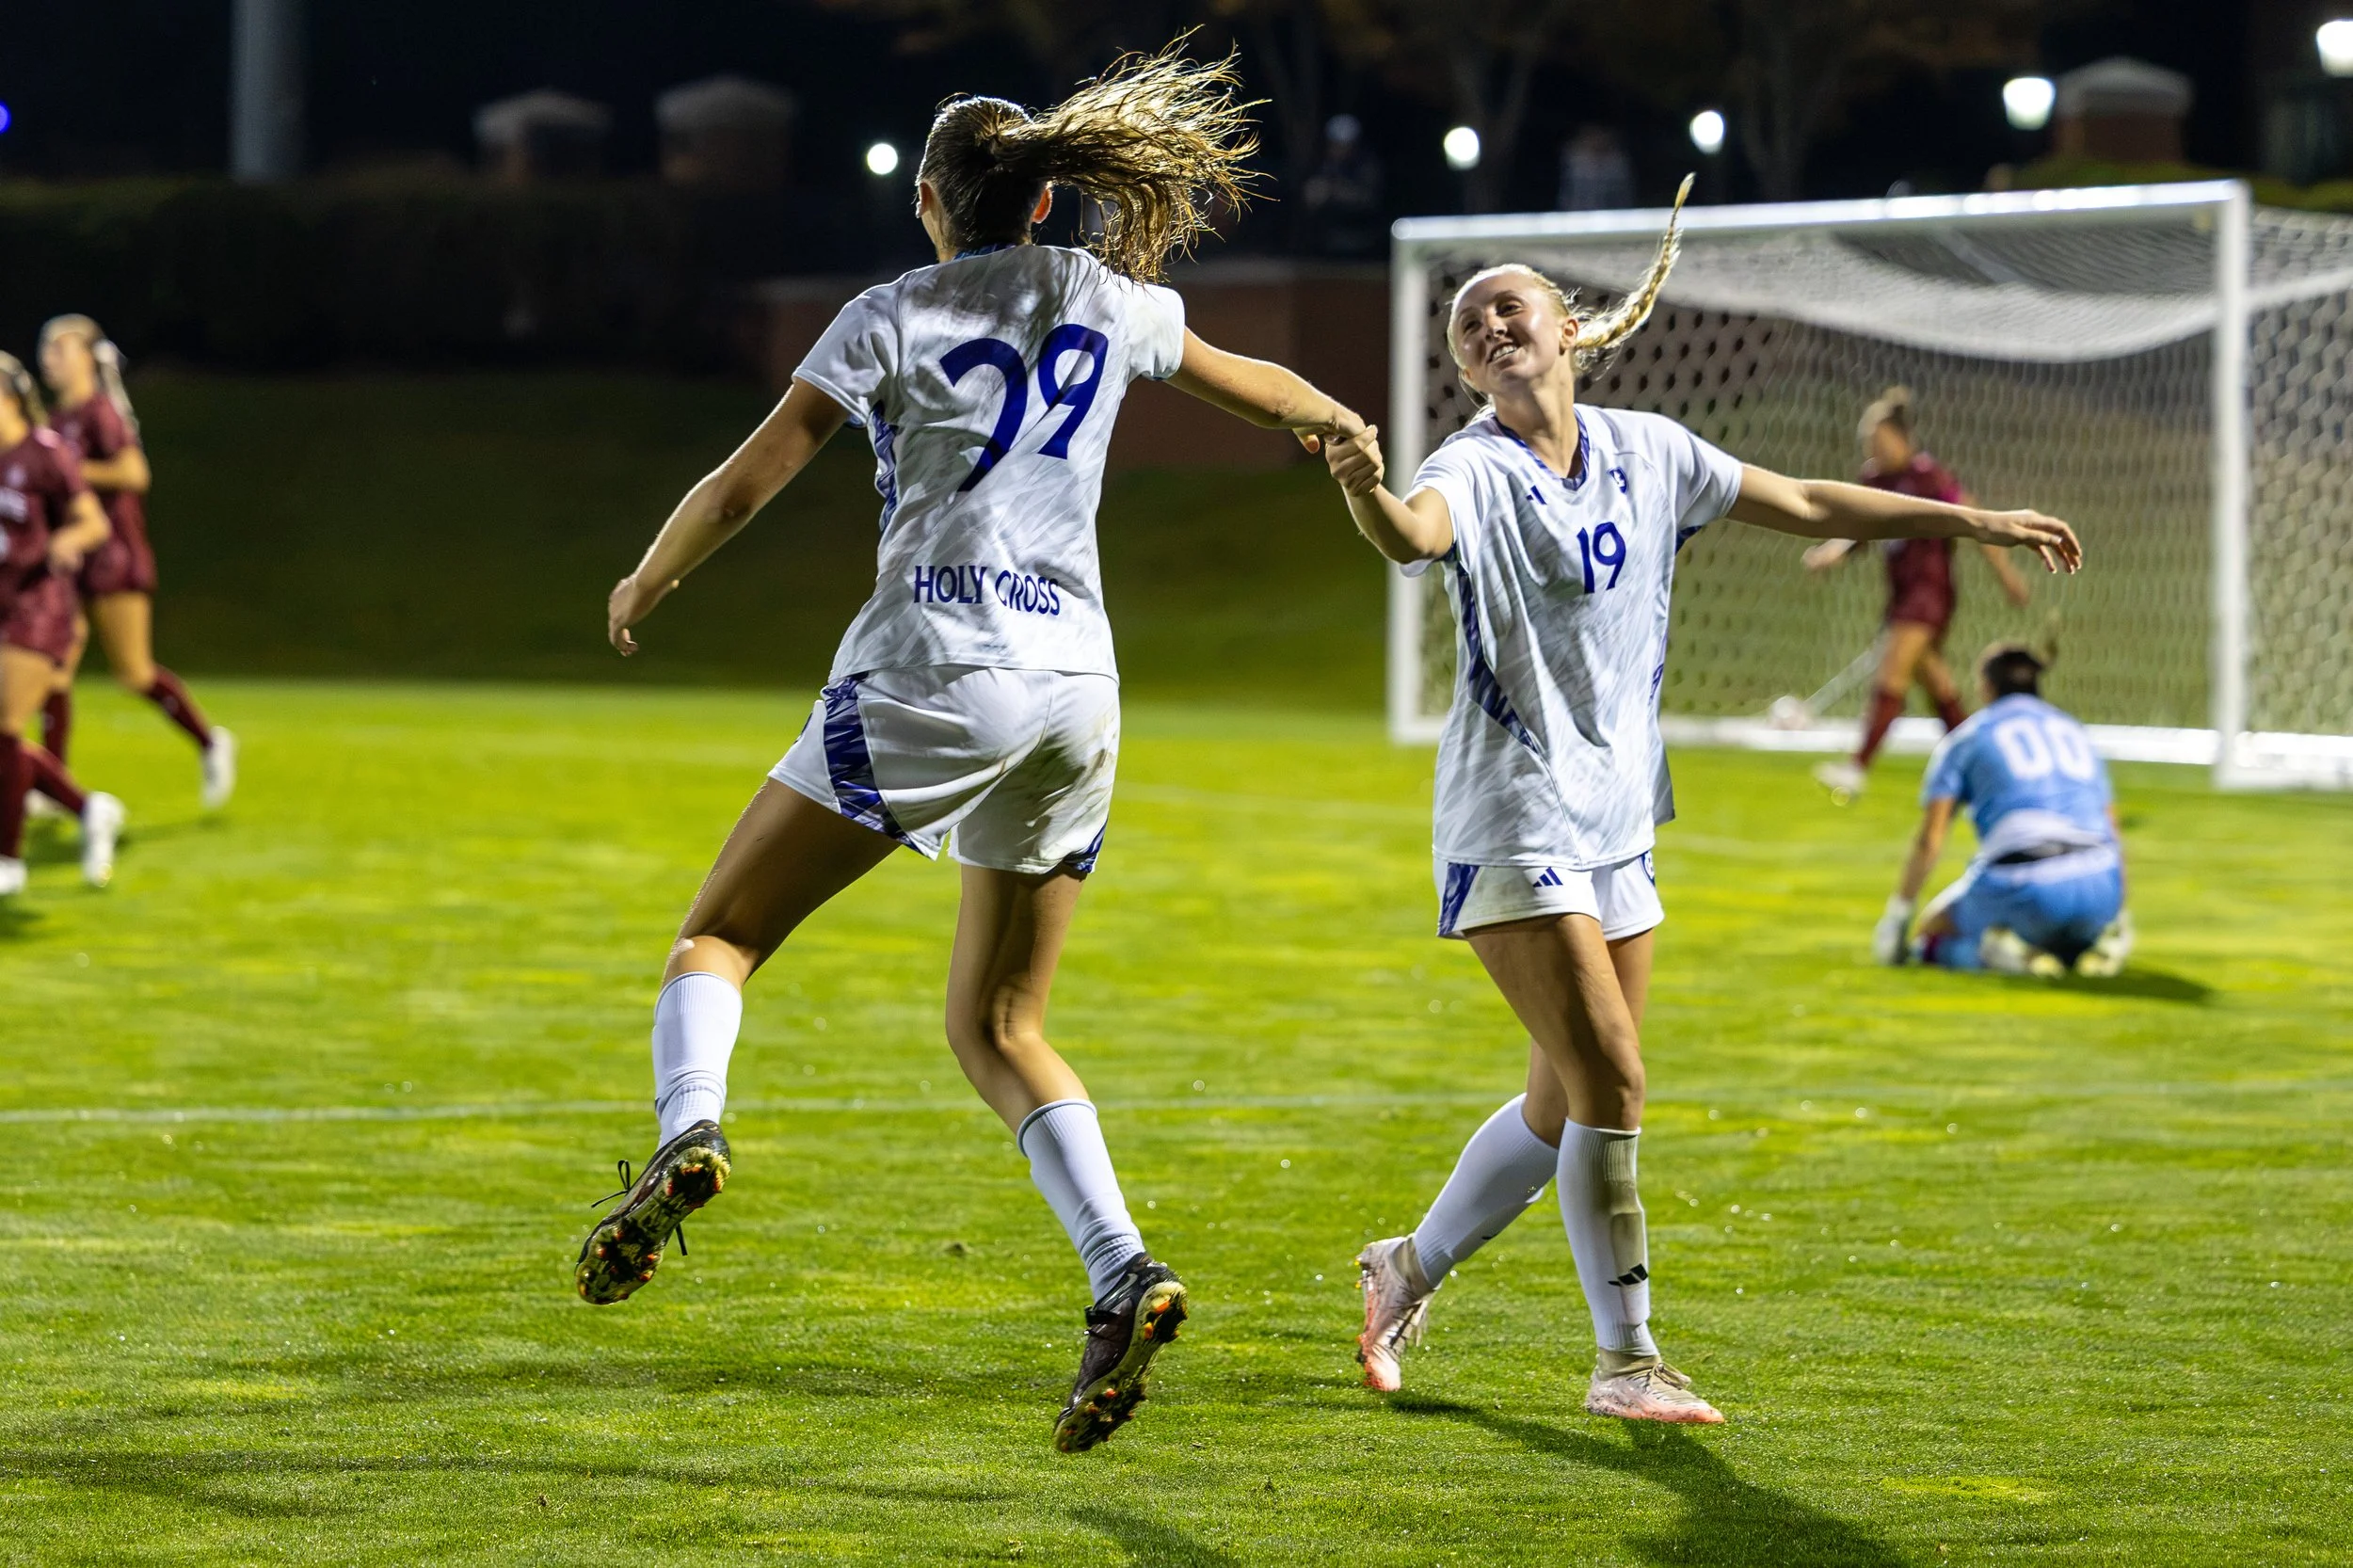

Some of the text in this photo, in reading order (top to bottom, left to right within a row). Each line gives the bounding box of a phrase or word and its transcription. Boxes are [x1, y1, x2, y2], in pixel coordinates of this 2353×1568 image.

[914, 565, 1061, 616] HOLY CROSS
[1577, 521, 1626, 594] 19
[1993, 714, 2096, 780] 00
